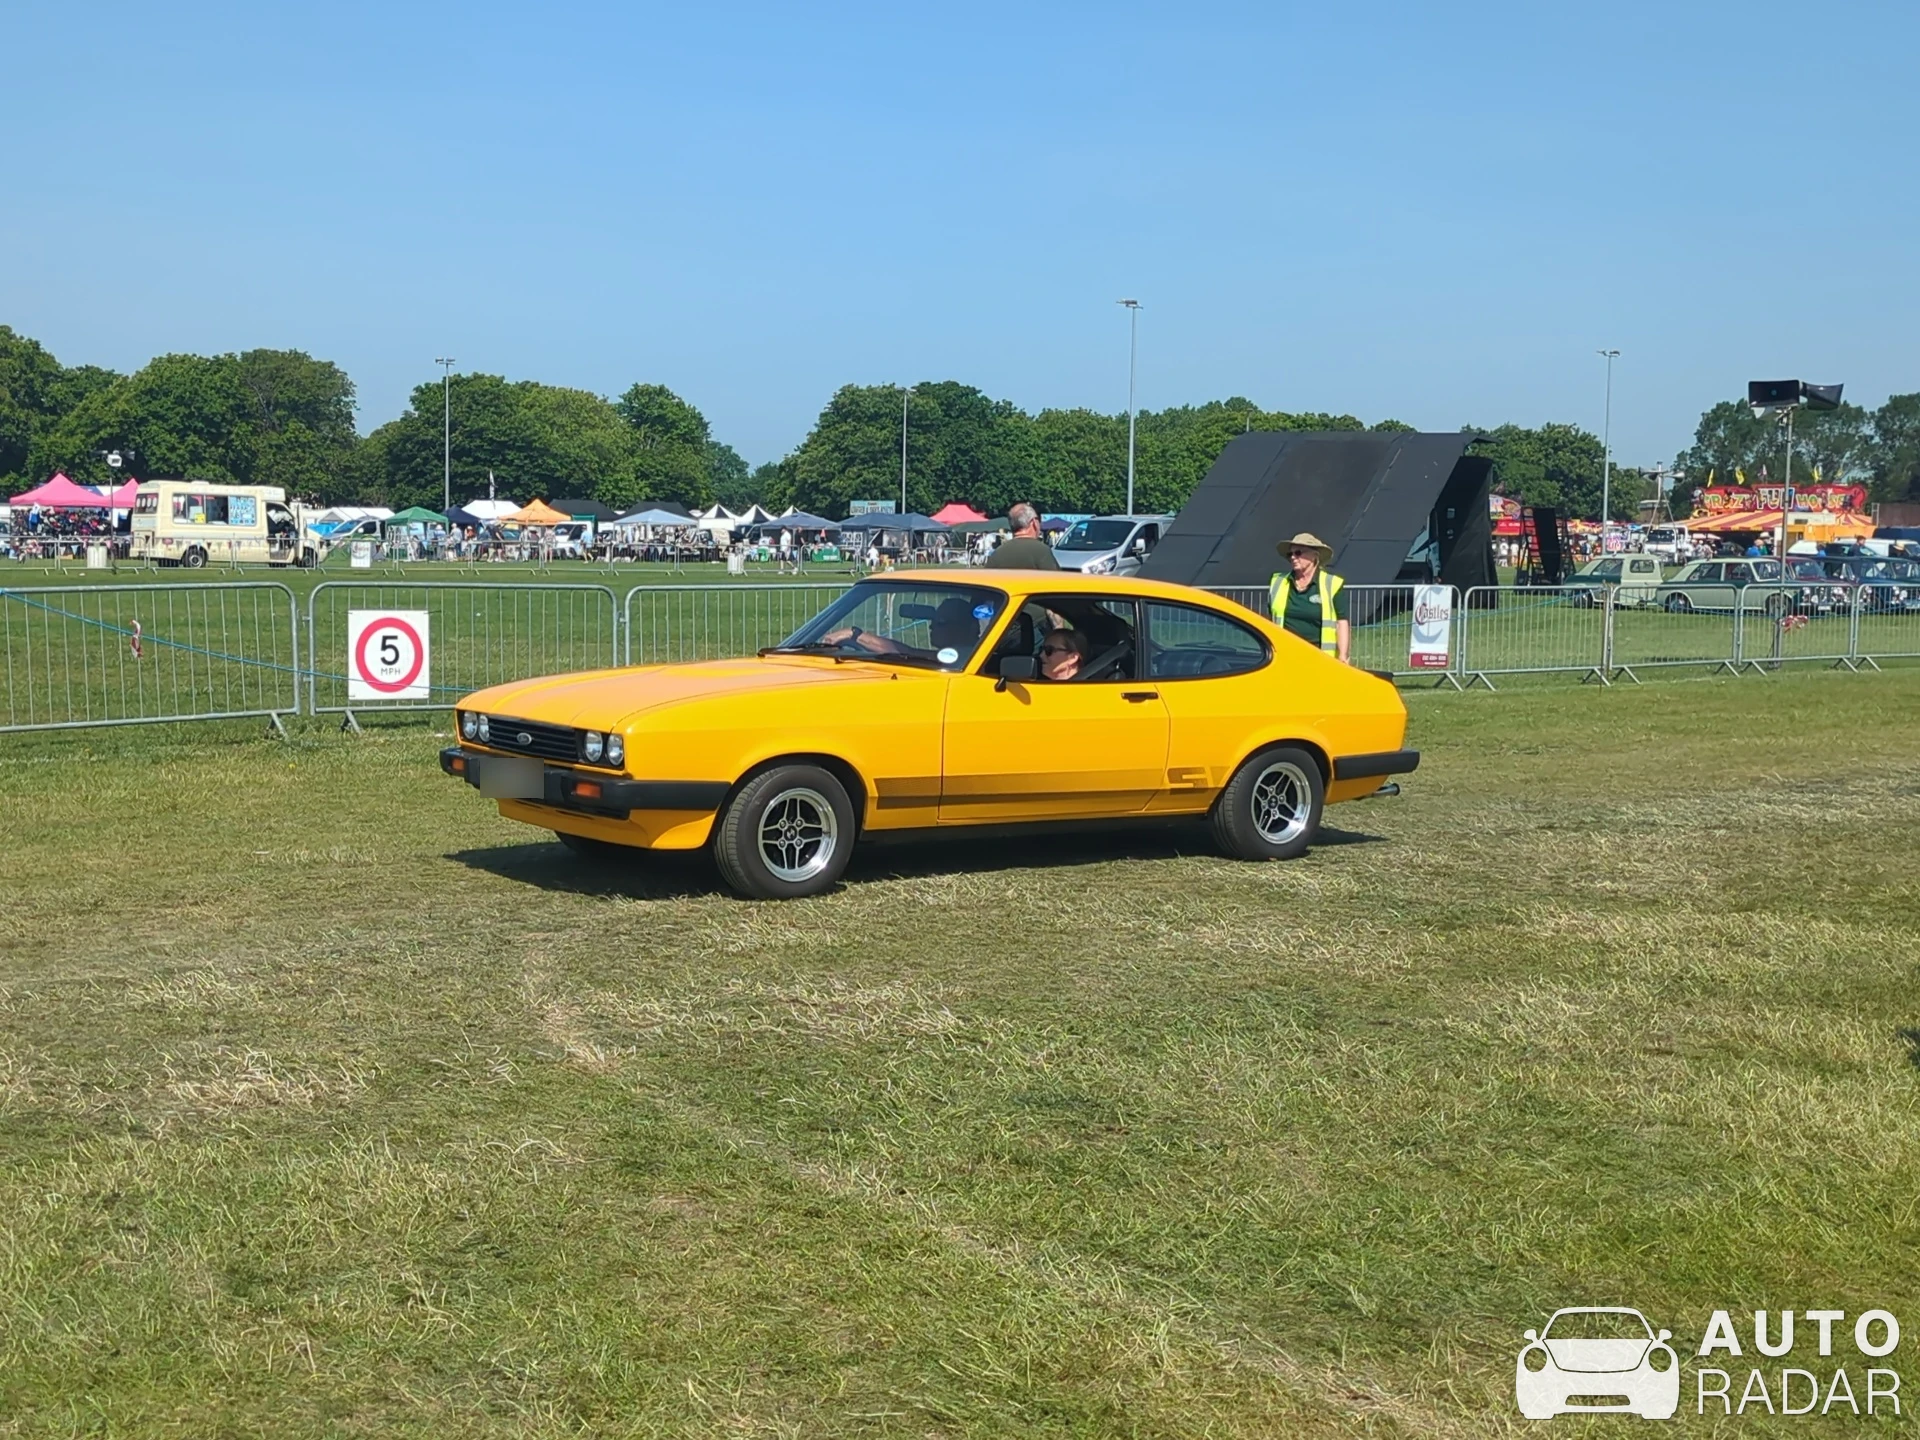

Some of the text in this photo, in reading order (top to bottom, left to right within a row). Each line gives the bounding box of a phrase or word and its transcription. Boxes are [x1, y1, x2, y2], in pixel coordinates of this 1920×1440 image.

[1756, 487, 1795, 510] FUN
[1415, 602, 1449, 625] Castles
[380, 634, 400, 666] 5
[380, 667, 401, 676] MPH
